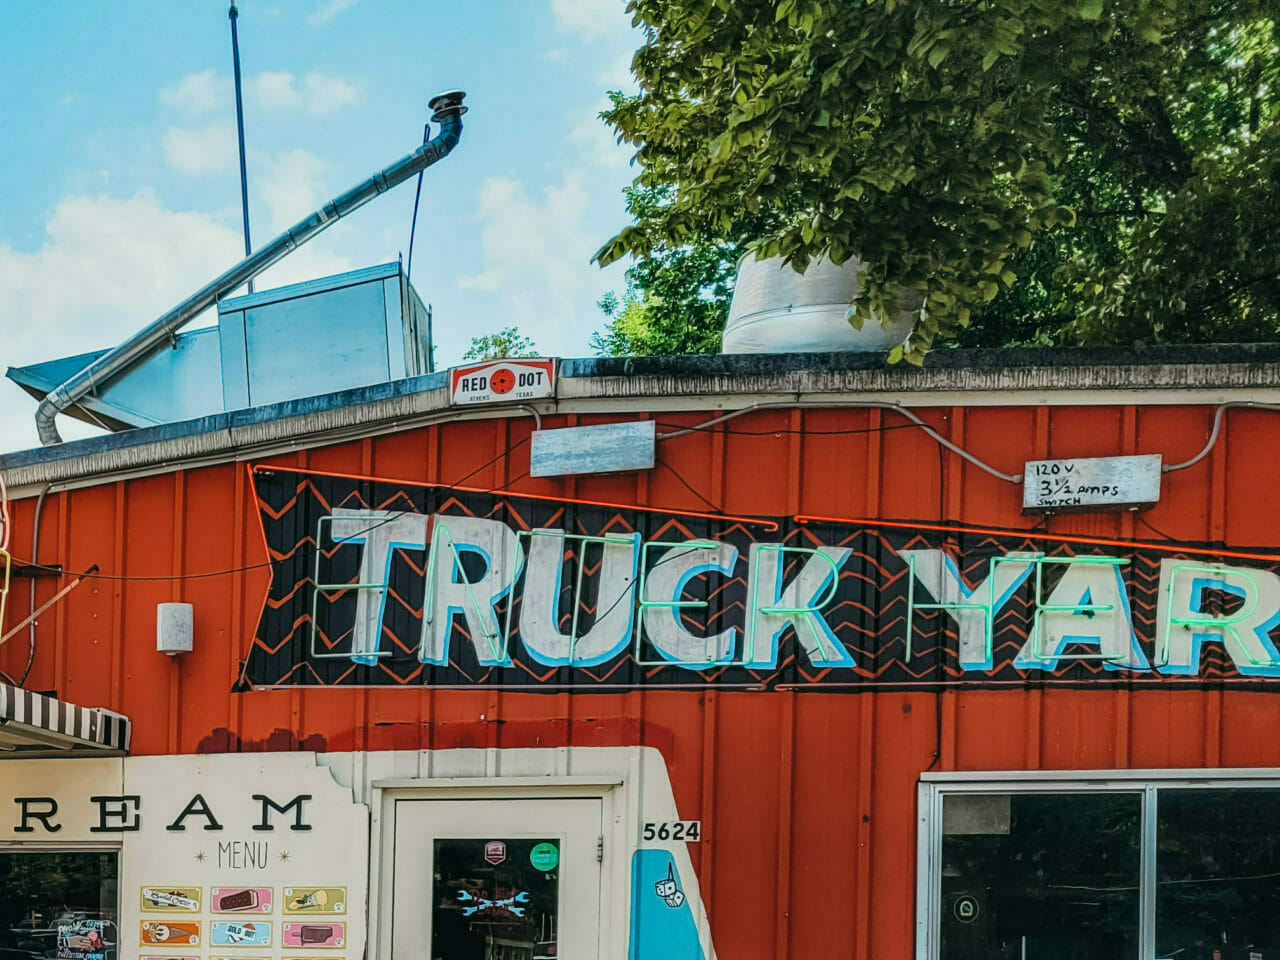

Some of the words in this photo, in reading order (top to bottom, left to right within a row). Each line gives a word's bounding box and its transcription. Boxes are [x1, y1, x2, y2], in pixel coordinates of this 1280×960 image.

[462, 377, 487, 392] RED
[519, 372, 543, 387] DOT
[1036, 464, 1061, 476] 120
[1037, 497, 1081, 506] SWITCH
[330, 508, 856, 670] TRUCK
[642, 822, 700, 842] 5624
[217, 840, 268, 870] MENU
